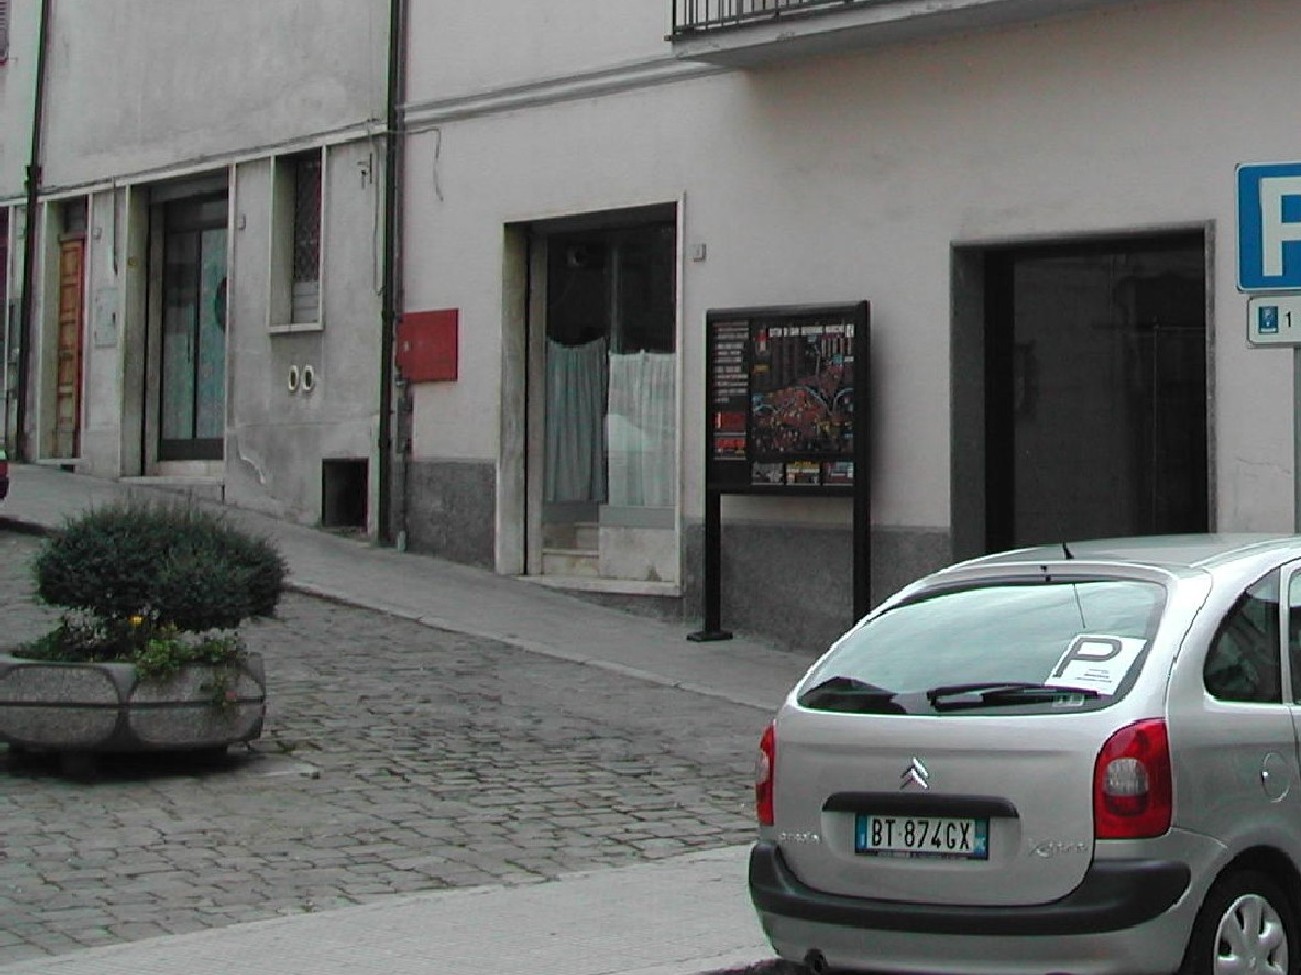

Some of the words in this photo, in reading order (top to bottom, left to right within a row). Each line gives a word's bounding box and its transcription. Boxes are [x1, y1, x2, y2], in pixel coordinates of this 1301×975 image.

[1285, 311, 1292, 328] 1
[1052, 637, 1122, 678] P
[871, 818, 896, 847] BT
[904, 819, 970, 850] 874GX
